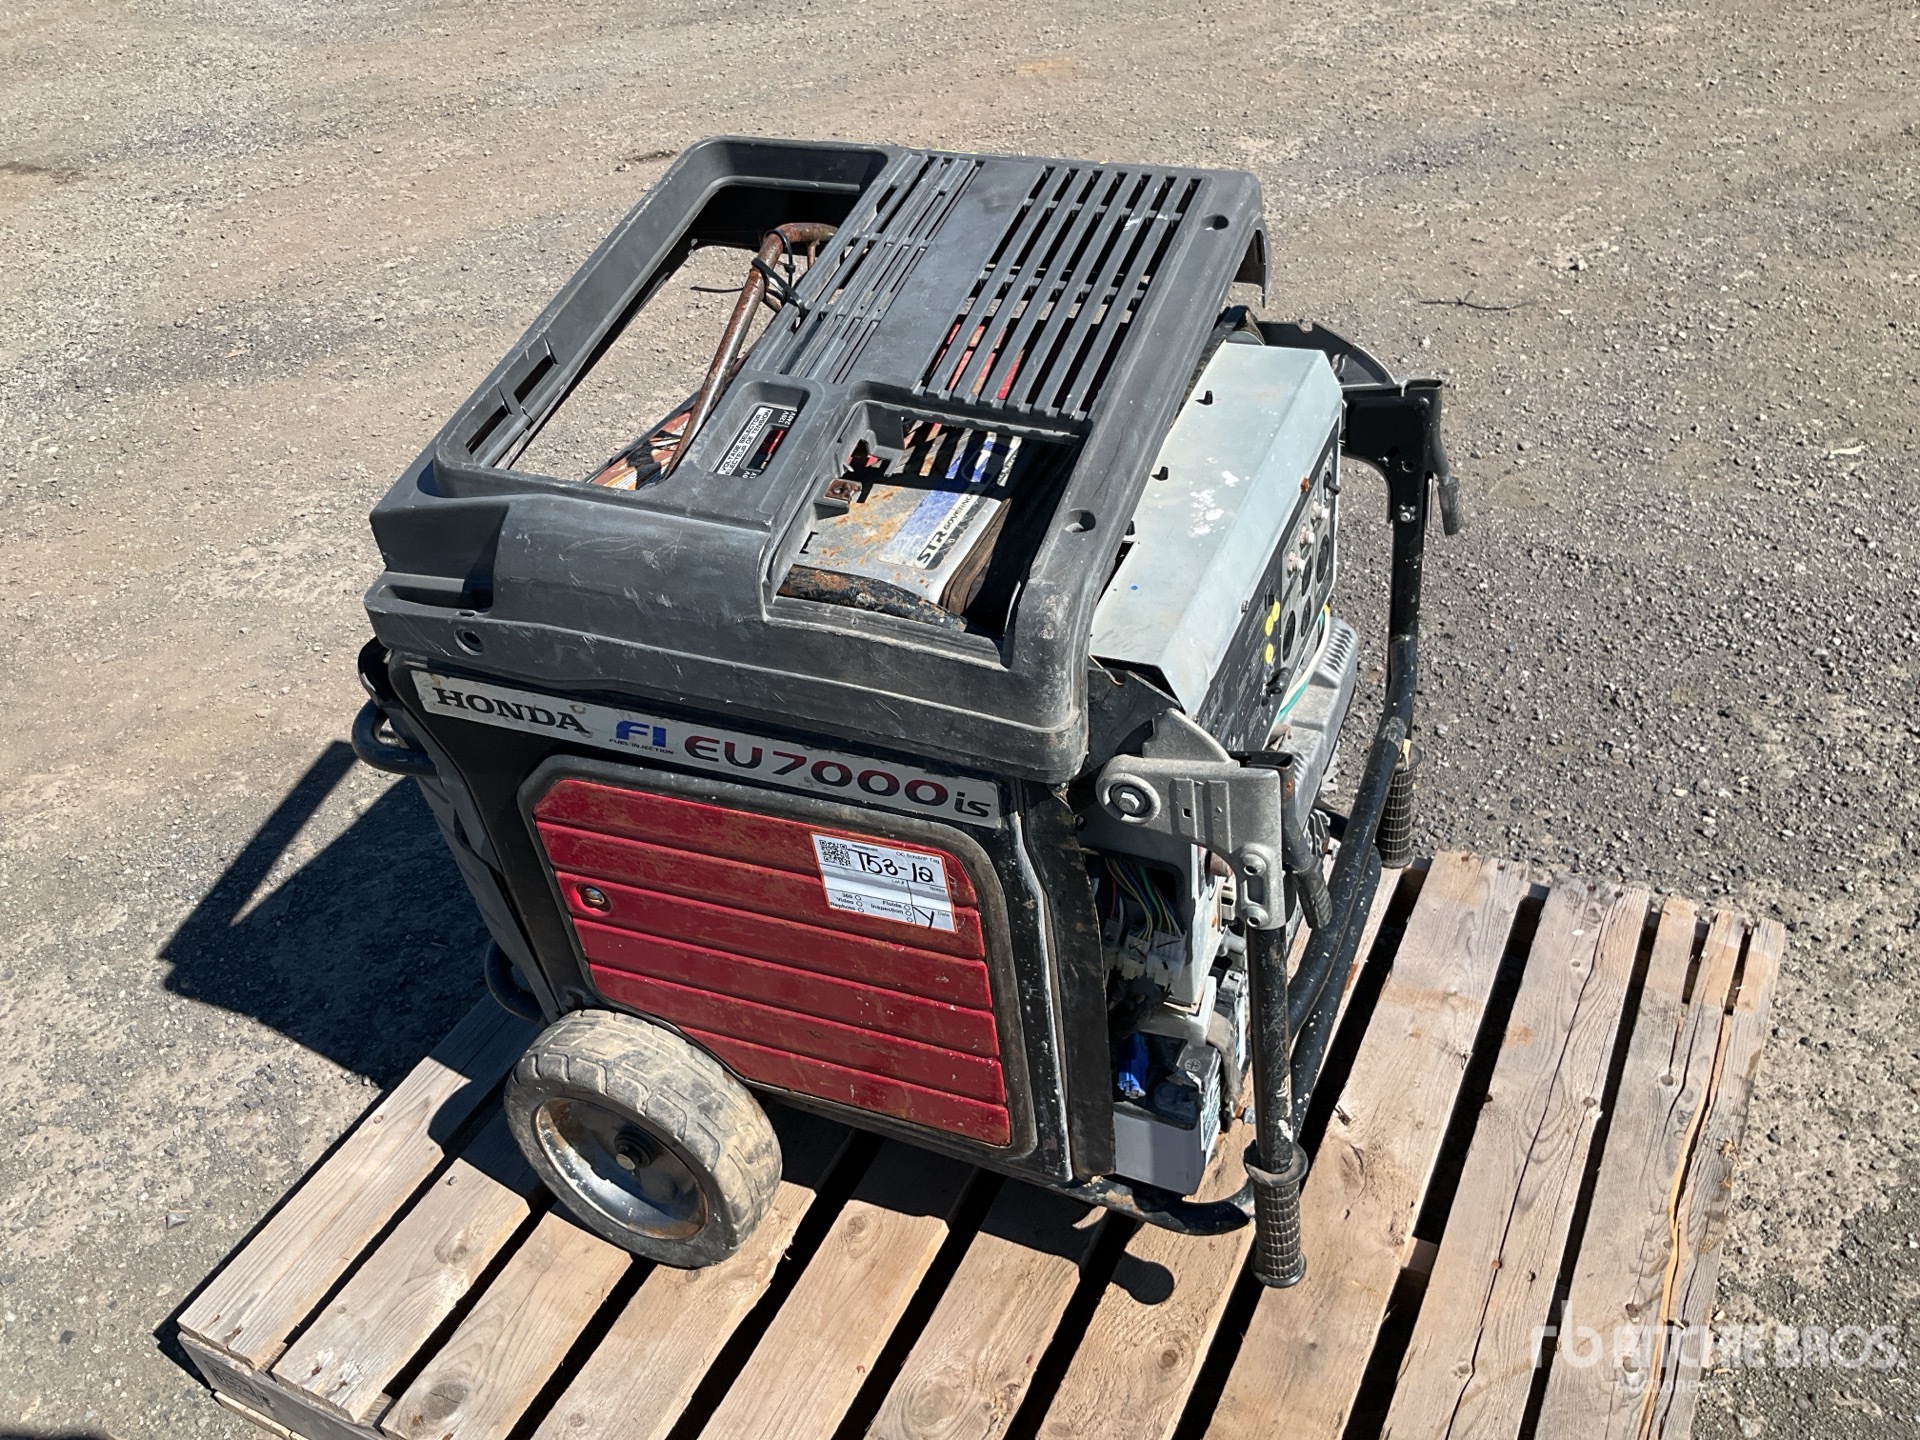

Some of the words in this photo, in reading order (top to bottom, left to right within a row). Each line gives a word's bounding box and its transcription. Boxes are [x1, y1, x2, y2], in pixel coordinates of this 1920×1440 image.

[784, 411, 797, 426] 240V
[722, 445, 741, 470] VOLTAGE
[739, 414, 761, 443] SELECTOR
[725, 445, 747, 474] ELECTEUR
[745, 435, 753, 444] DE
[751, 410, 771, 435] TENSION
[916, 529, 948, 564] STR
[432, 687, 591, 734] HONDA
[616, 720, 667, 748] FI
[609, 738, 630, 746] FUEL
[631, 743, 673, 754] INJECTION
[835, 897, 854, 905] Video
[871, 904, 904, 914] Inspection
[883, 900, 902, 908] Fluids
